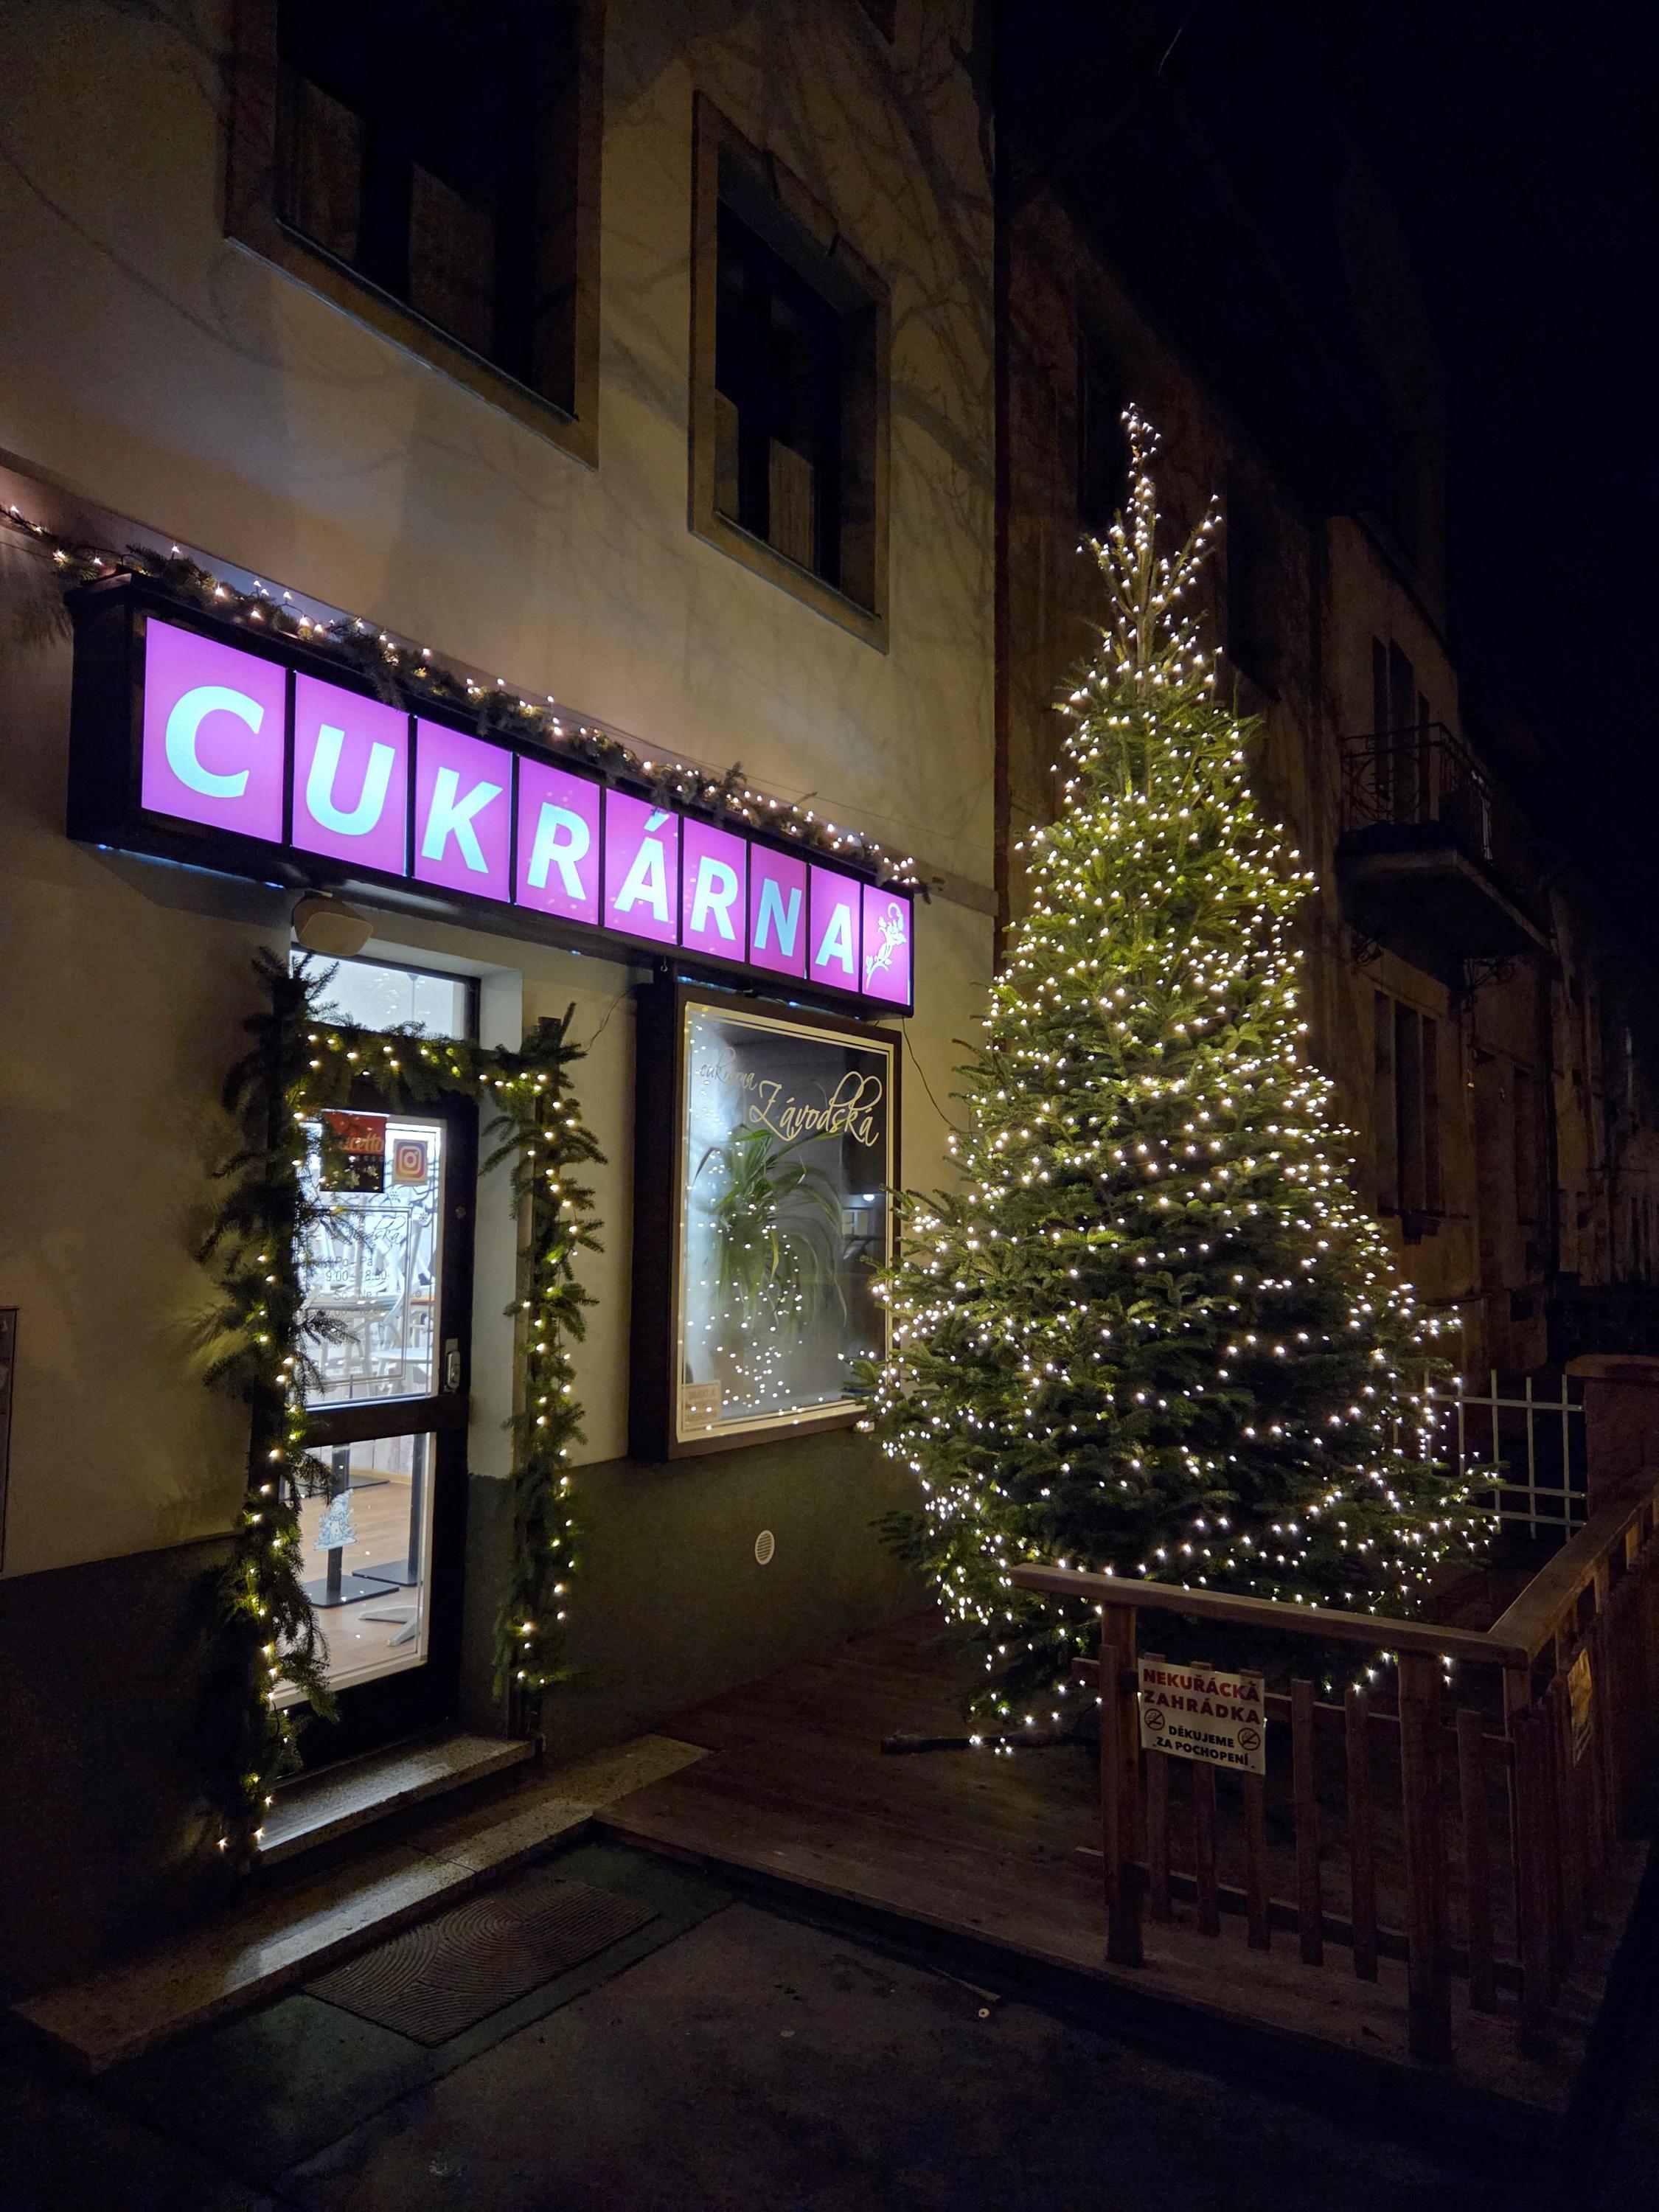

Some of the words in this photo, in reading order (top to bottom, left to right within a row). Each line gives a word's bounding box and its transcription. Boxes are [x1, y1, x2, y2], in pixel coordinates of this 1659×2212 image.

[165, 686, 855, 975] CUKRÁRNA
[749, 1071, 882, 1147] Závodská
[1144, 1668, 1260, 1703] NEKUŘÁCKÁ
[1144, 1689, 1261, 1725] ZAHRÁDKA
[1156, 1736, 1173, 1749] ZA
[1175, 1741, 1248, 1766] POCHOPENÍ
[1168, 1725, 1234, 1748] DĚKUJEME
